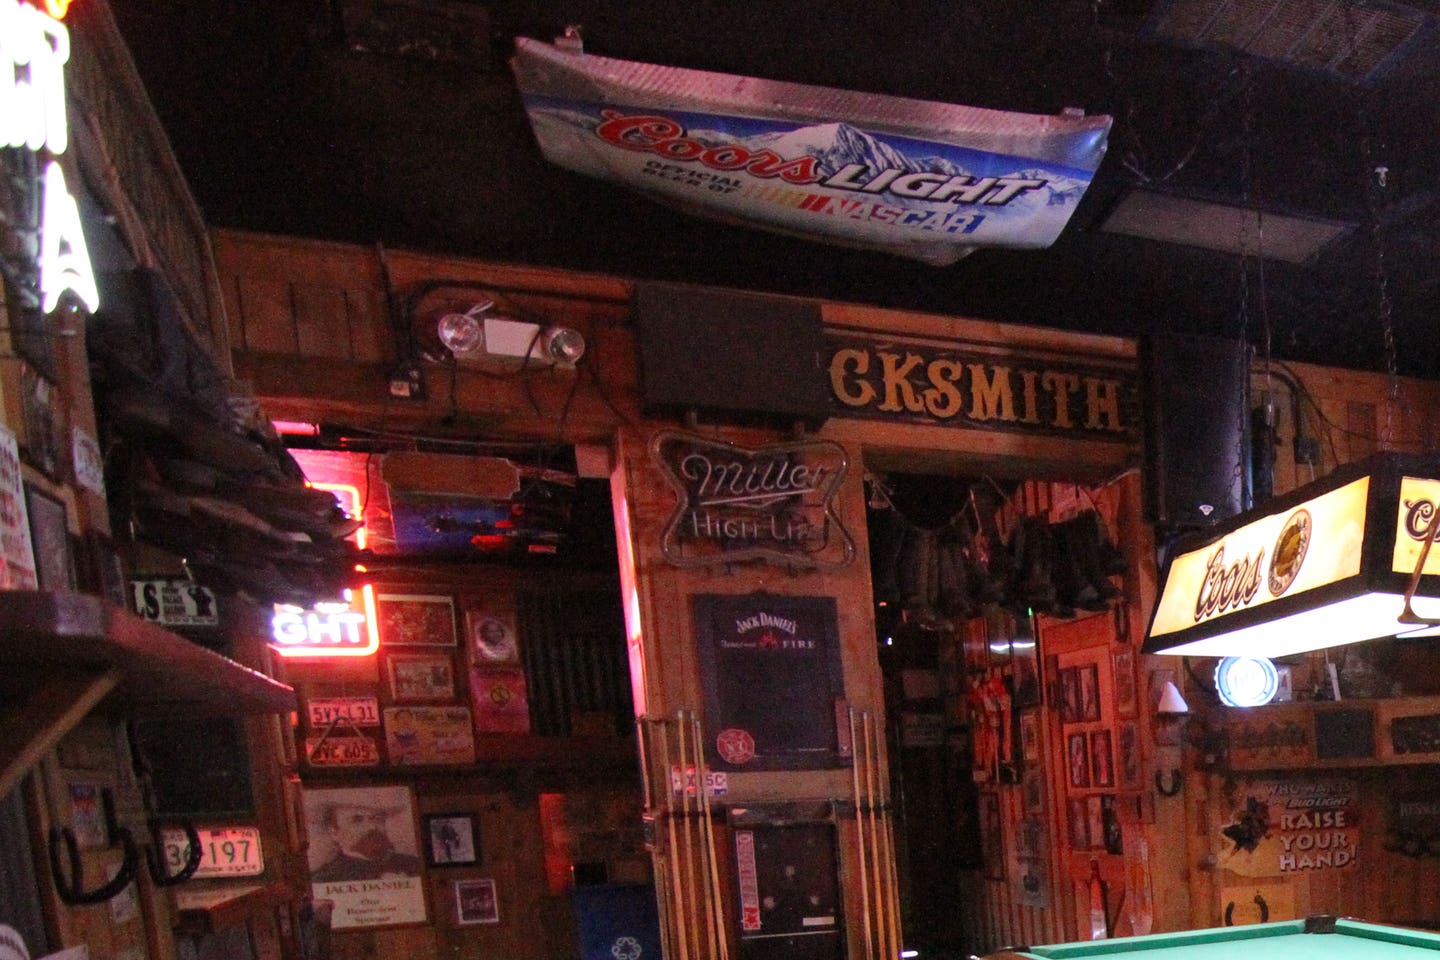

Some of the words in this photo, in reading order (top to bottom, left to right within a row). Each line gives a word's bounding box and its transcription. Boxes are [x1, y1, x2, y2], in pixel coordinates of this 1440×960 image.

[597, 109, 820, 184] Coors
[820, 164, 1047, 206] LIGHT
[681, 454, 824, 496] Miller
[1194, 541, 1265, 622] Coors
[1280, 811, 1346, 831] RAISE
[208, 840, 250, 865] 197
[1280, 831, 1349, 852] YOUR
[1279, 844, 1358, 871] HAND!
[326, 884, 359, 895] JACK
